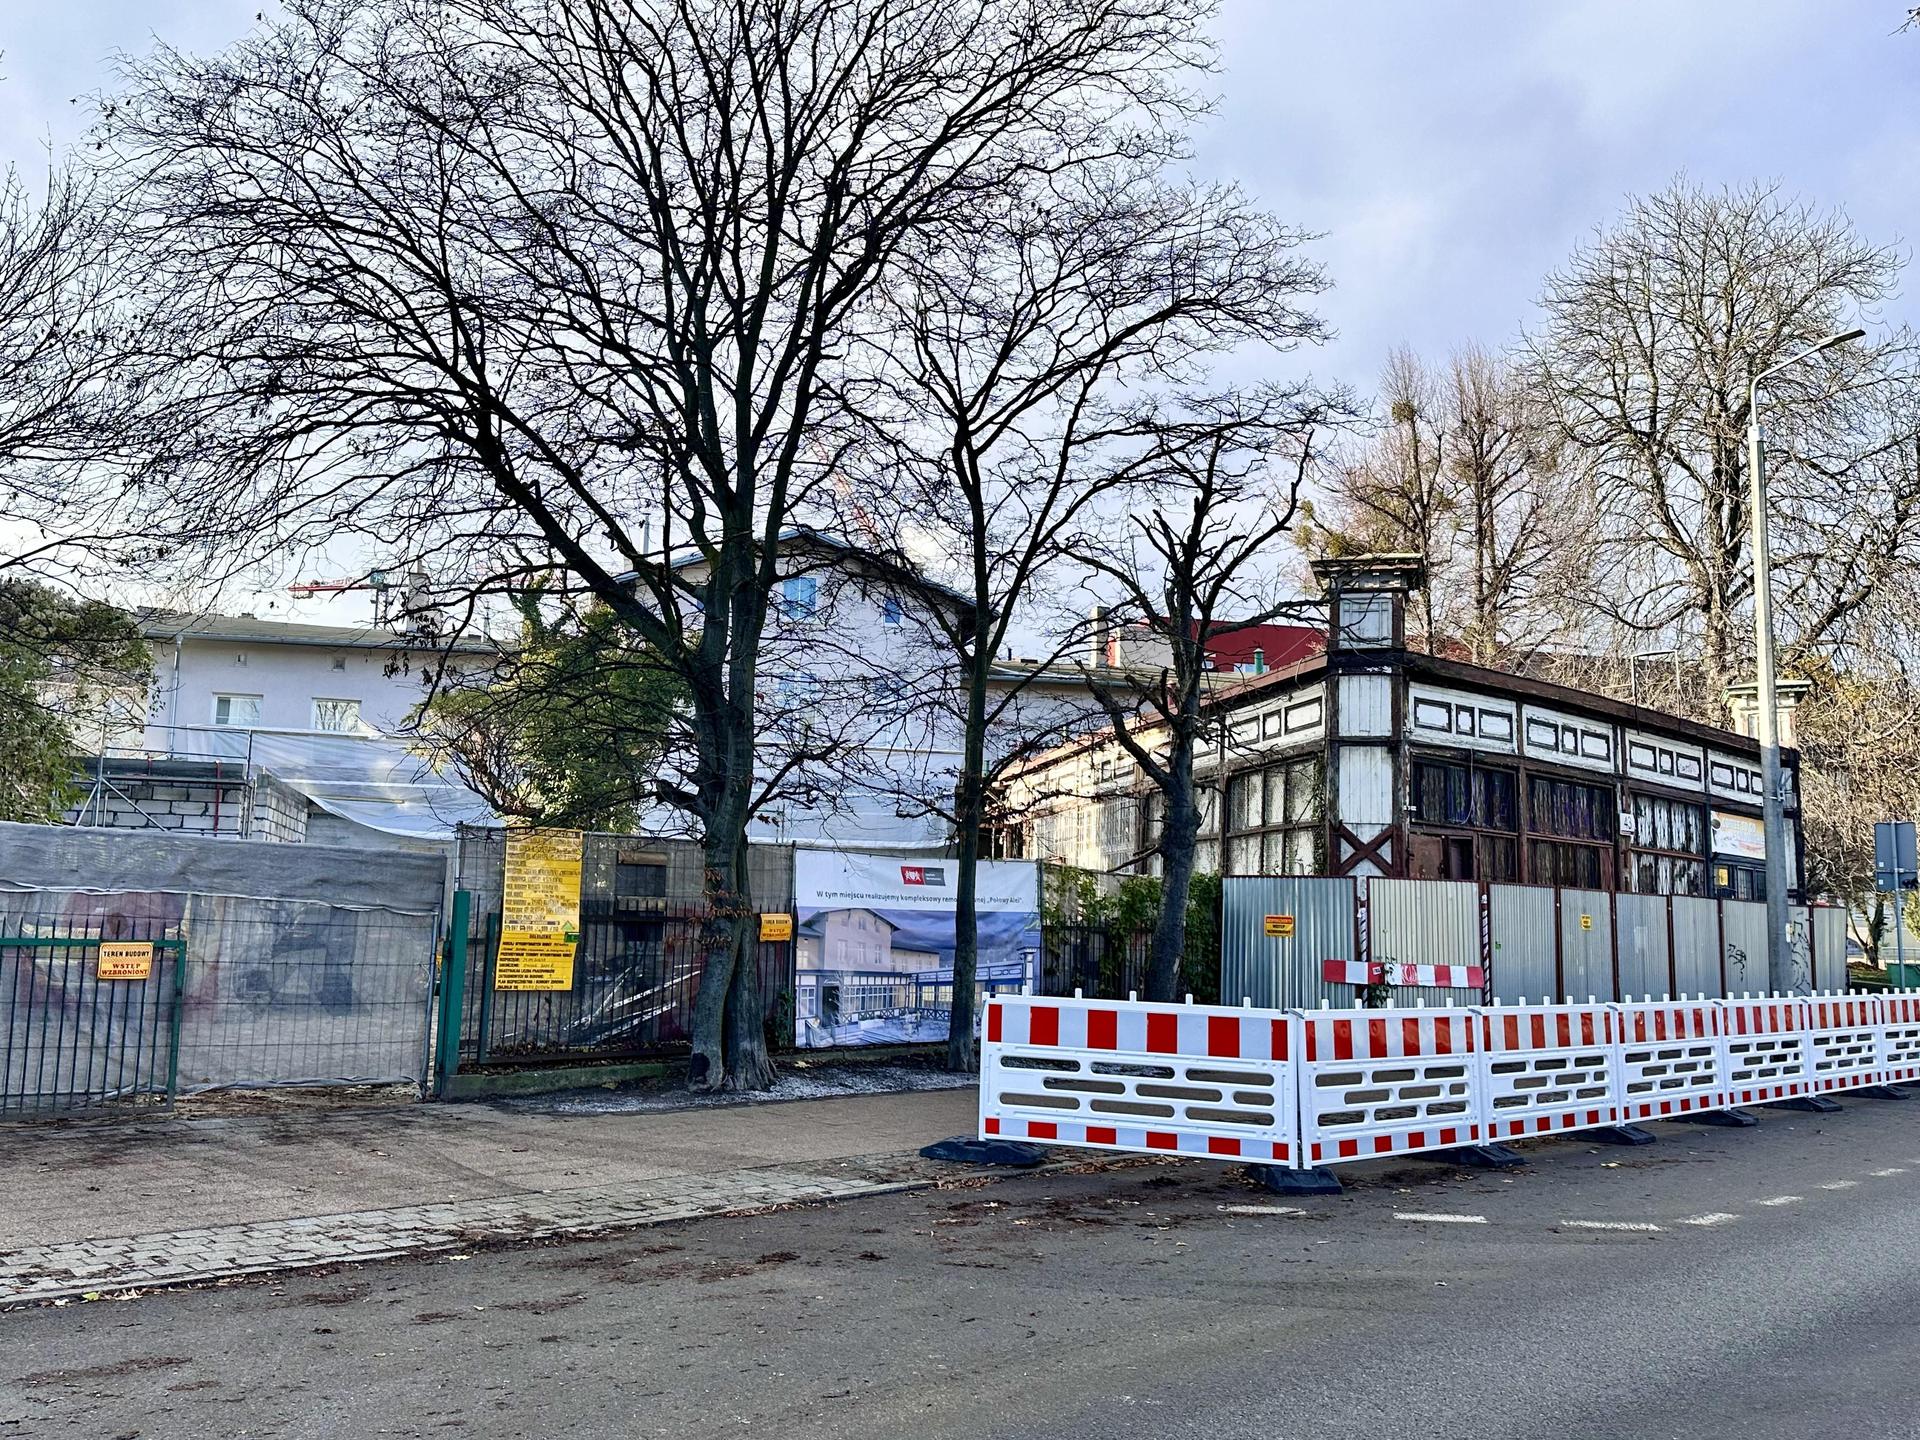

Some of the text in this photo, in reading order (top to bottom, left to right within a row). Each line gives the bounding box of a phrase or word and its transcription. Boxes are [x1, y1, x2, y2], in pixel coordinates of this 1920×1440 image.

[825, 891, 838, 899] tym
[839, 891, 864, 900] miejscu
[865, 893, 899, 901] realizujemy
[900, 894, 941, 904] kompleksowy
